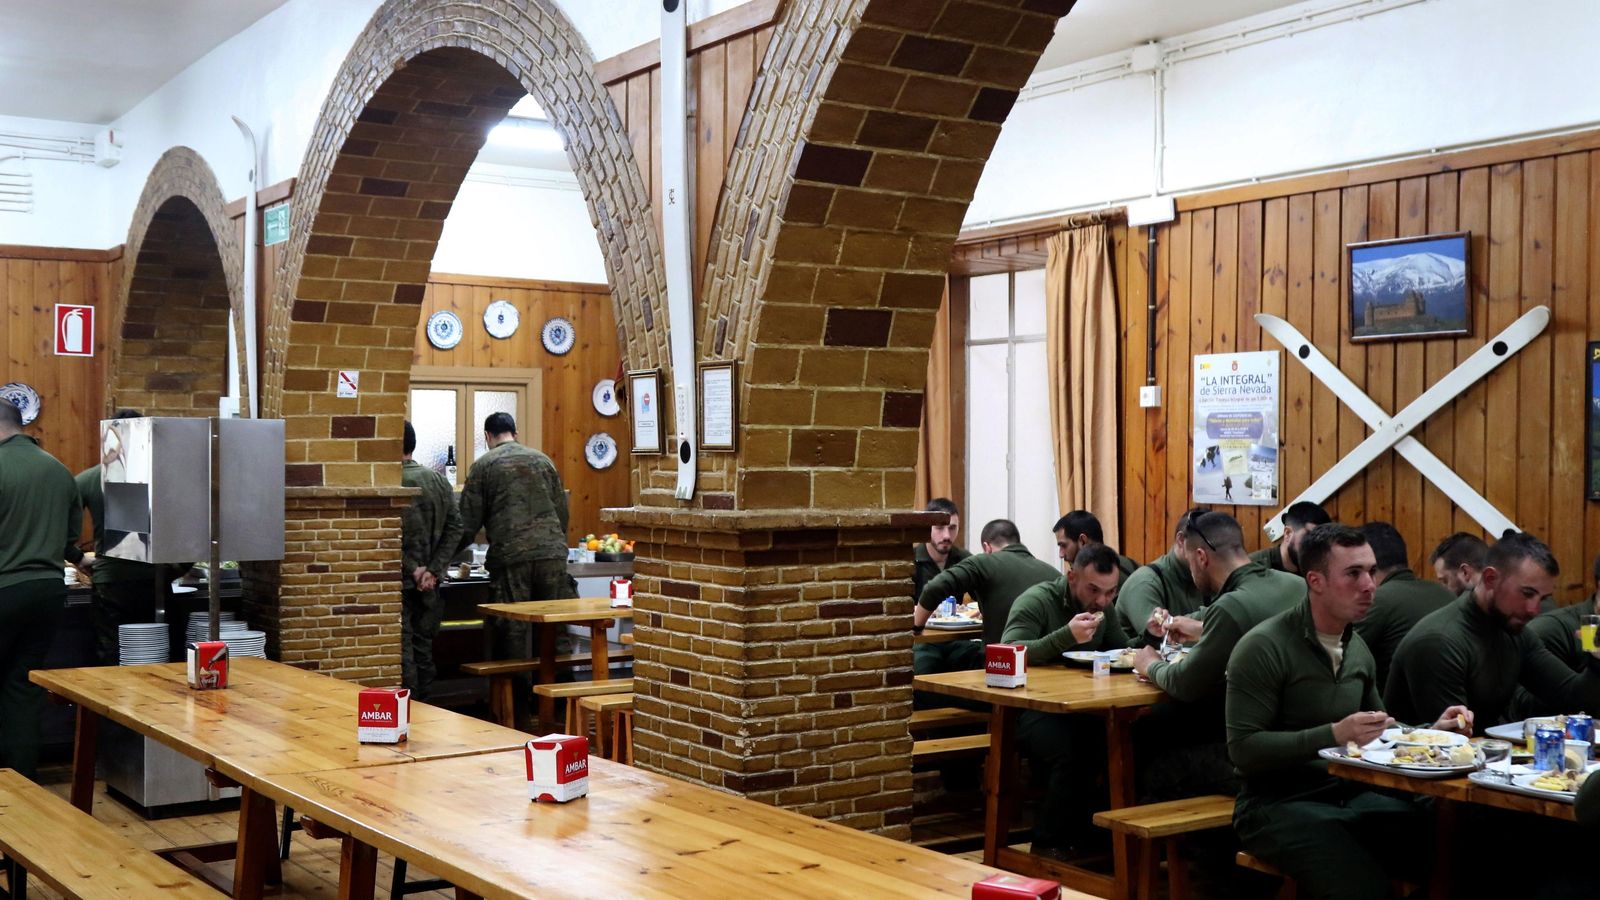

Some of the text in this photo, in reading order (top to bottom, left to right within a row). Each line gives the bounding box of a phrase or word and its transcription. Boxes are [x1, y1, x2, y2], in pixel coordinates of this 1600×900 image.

[1200, 385, 1272, 396] de Sierra Nevada
[988, 661, 1011, 670] AMBAR
[361, 711, 392, 720] AMBAR
[565, 758, 587, 774] AMBAR
